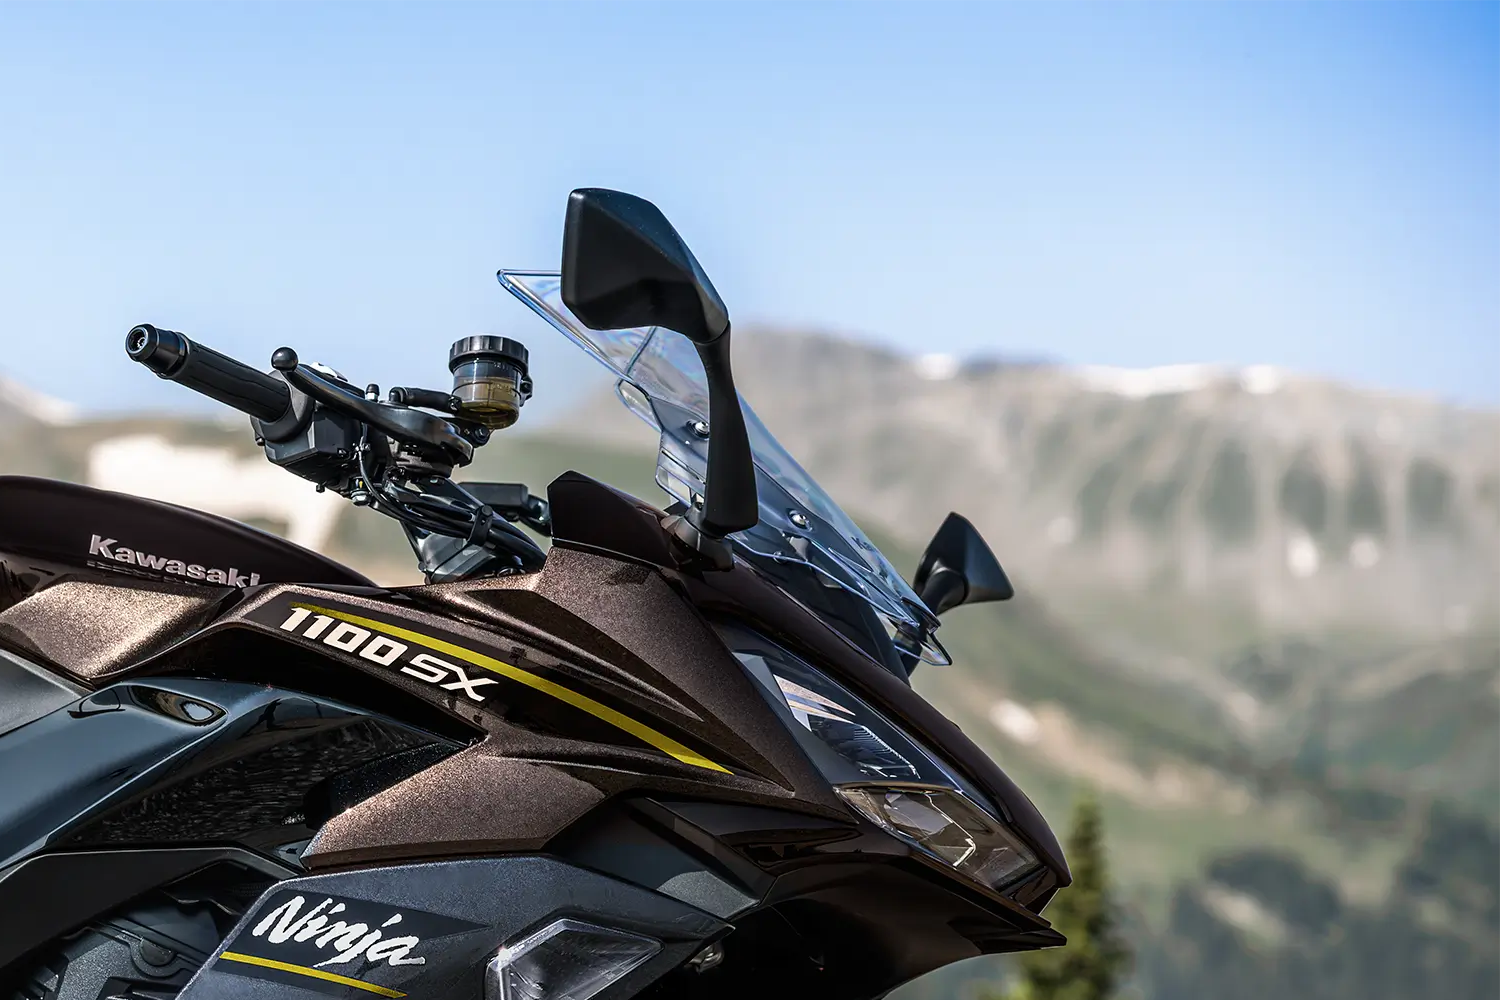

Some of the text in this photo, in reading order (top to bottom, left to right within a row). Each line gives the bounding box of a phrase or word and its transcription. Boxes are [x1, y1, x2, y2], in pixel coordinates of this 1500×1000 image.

[88, 534, 260, 588] Kawasaki
[280, 607, 498, 702] 1100 SX
[252, 895, 425, 967] Ninja
